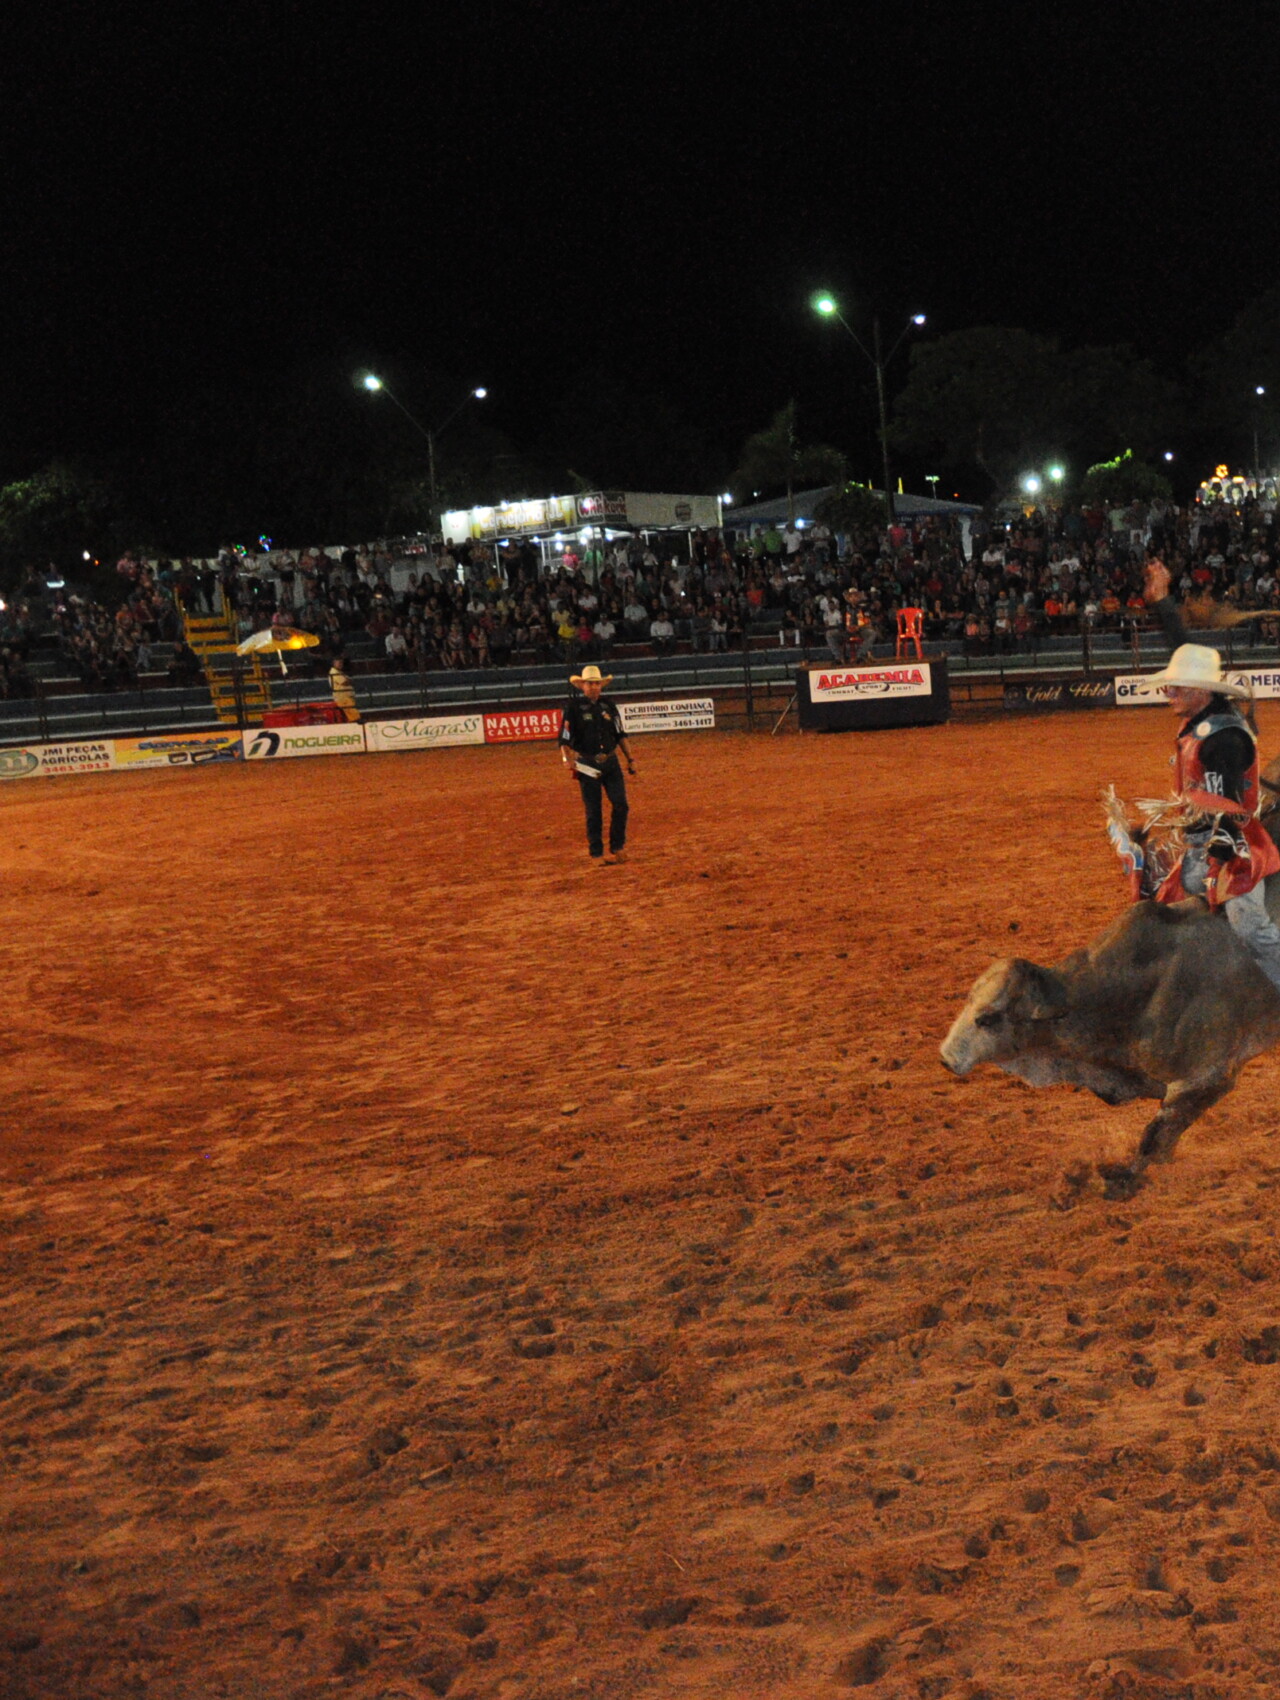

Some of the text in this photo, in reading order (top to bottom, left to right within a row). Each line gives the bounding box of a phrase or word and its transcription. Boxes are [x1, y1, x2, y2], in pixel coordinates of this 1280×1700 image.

[817, 669, 925, 690] ACADEMIA
[624, 702, 712, 714] ESCRITÓRIO CONFIANÇA
[486, 712, 558, 729] NAVIRAÍ
[381, 717, 480, 739] Magrass
[488, 725, 559, 736] CALÇADOS
[284, 734, 361, 749] NOGUEIRA
[41, 752, 110, 766] AGRÍCOLAS
[43, 747, 62, 757] JMI
